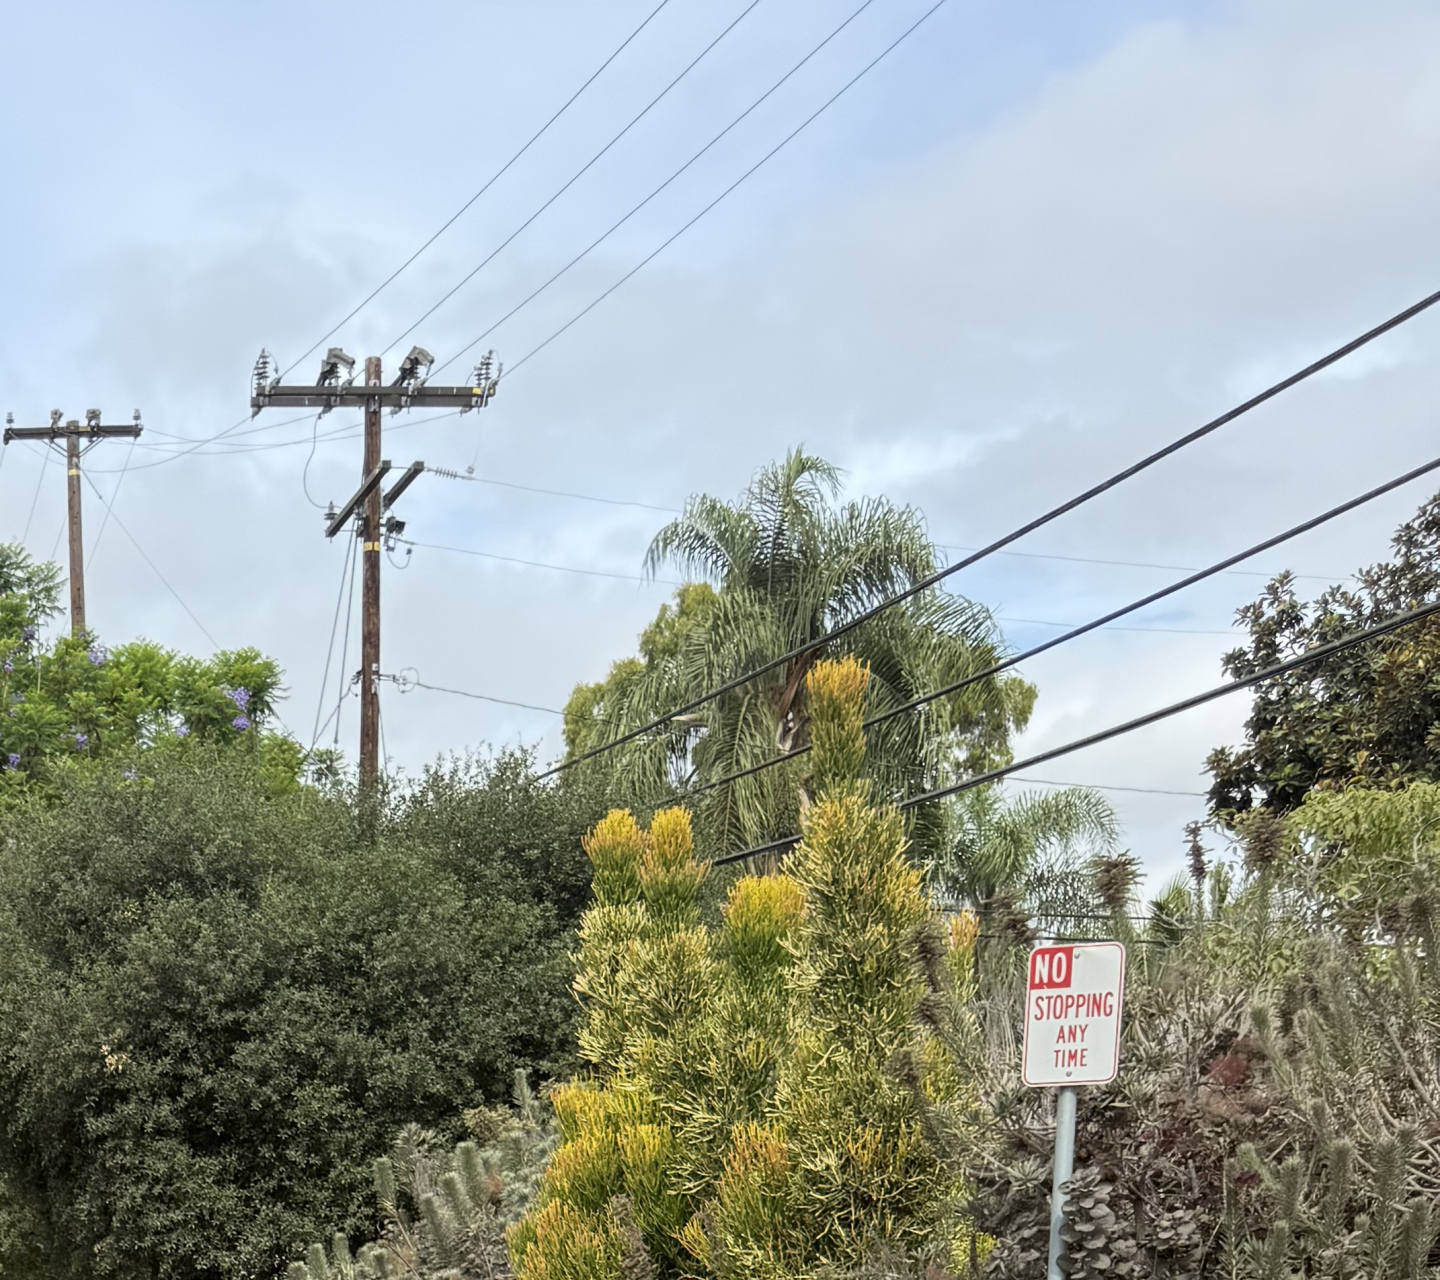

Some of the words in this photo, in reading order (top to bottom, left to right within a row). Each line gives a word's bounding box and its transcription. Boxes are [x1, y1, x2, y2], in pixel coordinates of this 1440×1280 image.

[1034, 951, 1067, 985] NO
[1034, 991, 1114, 1021] STOPPING
[1056, 1024, 1089, 1044] ANY
[1054, 1048, 1089, 1068] TIME
